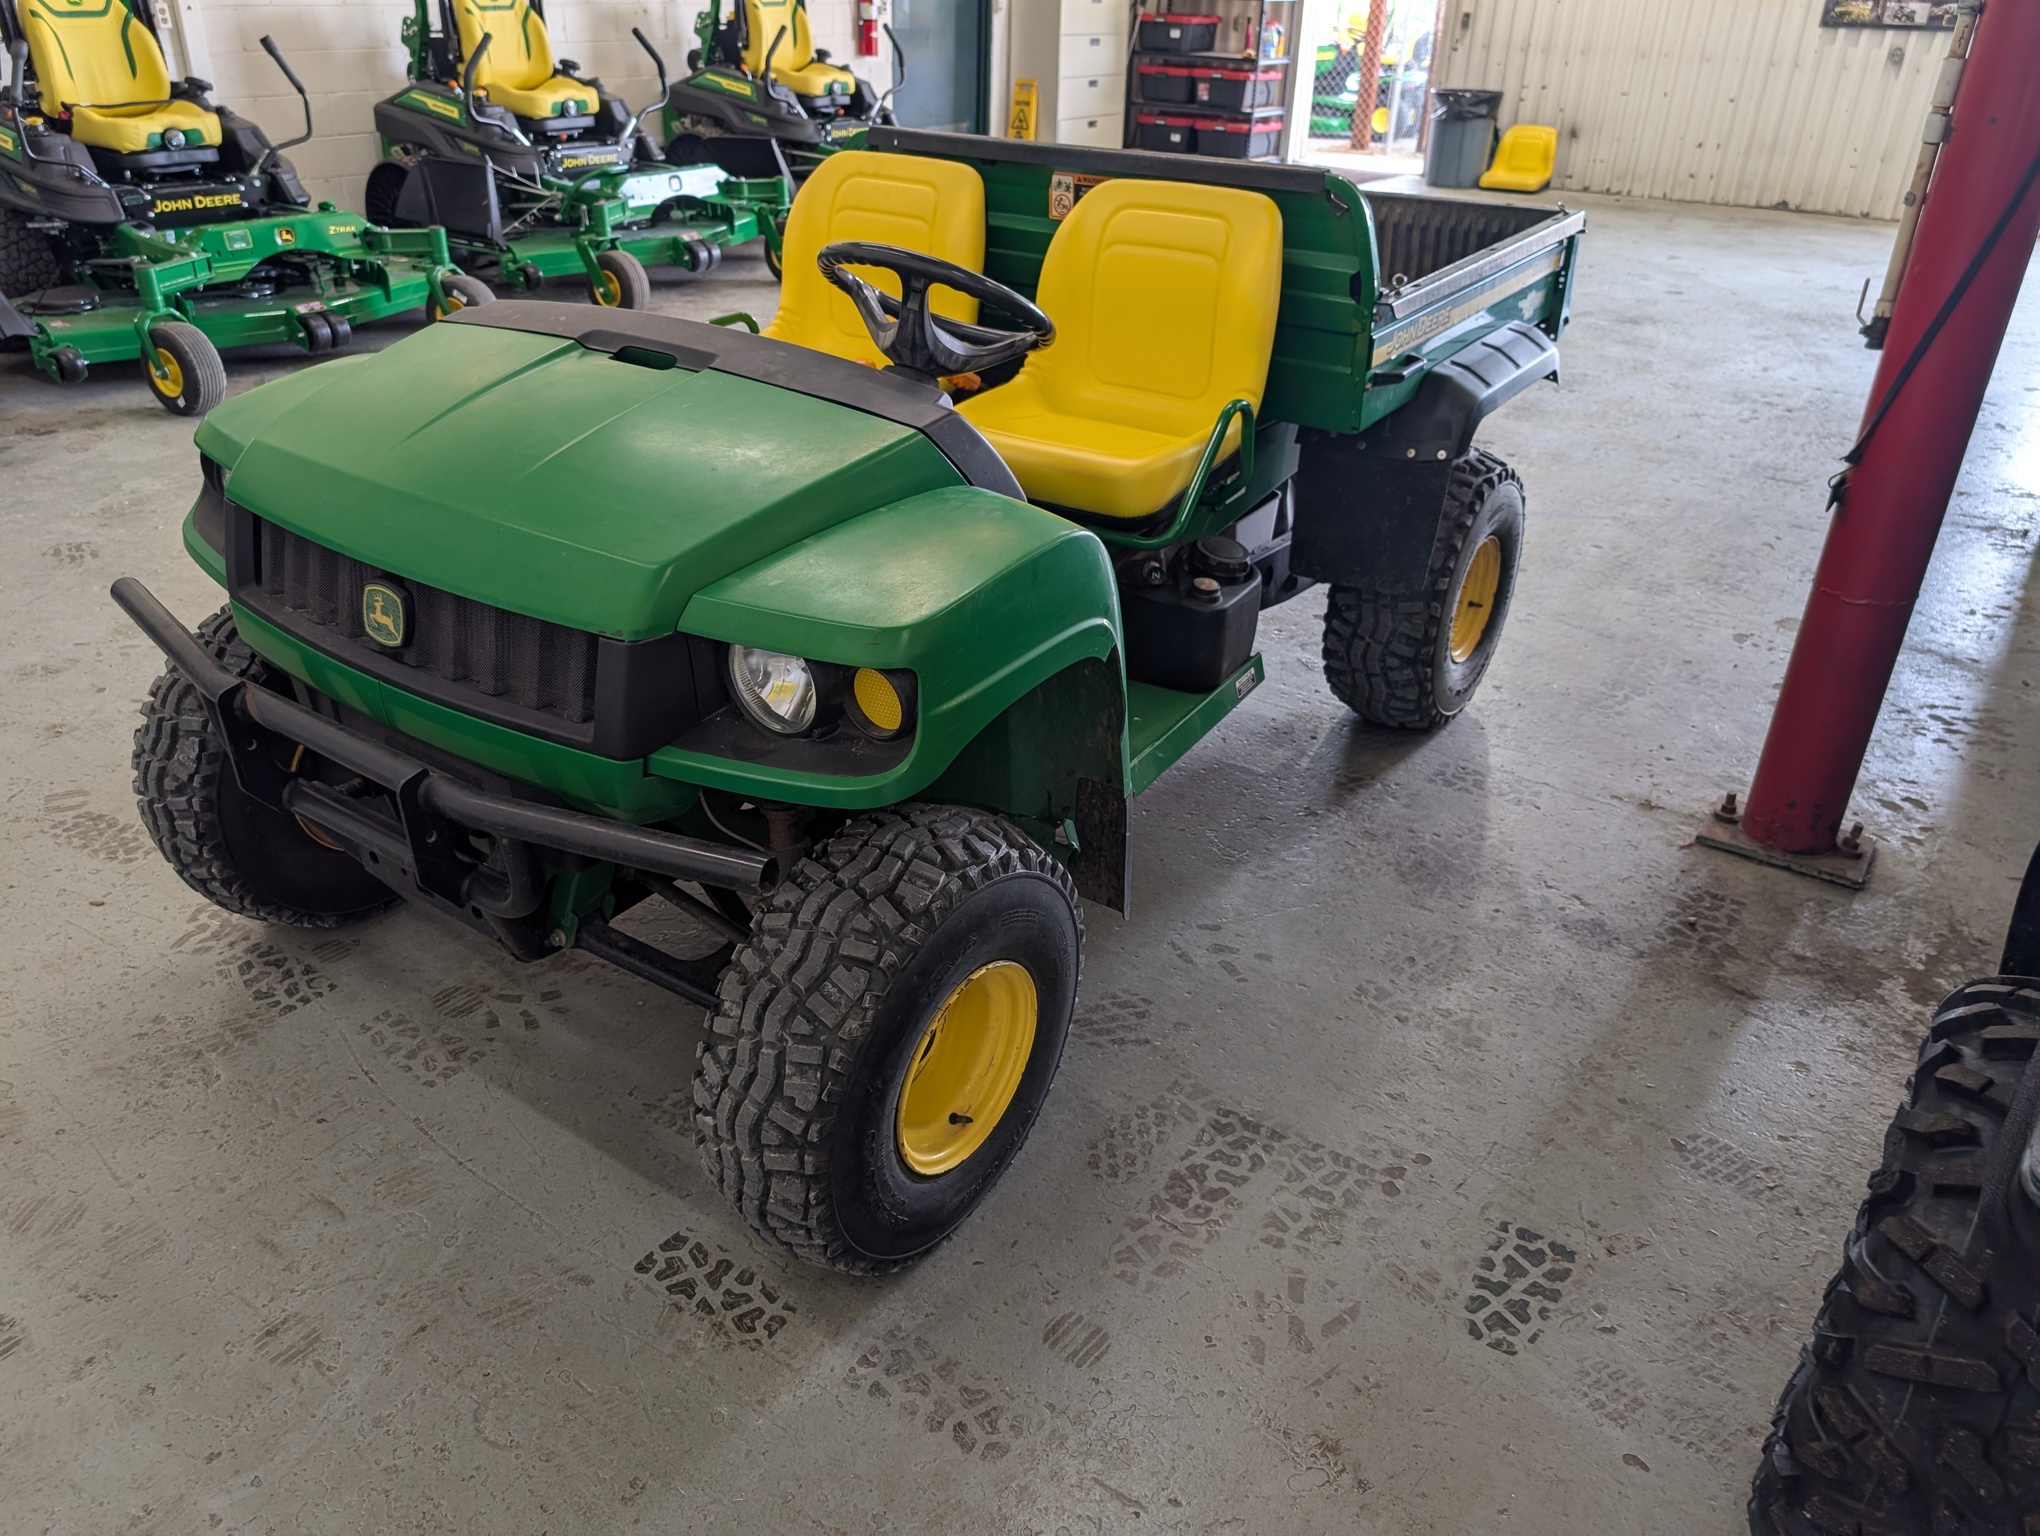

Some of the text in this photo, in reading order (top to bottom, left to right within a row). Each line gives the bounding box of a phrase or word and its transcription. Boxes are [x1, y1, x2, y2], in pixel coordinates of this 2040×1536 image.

[562, 154, 618, 168] JOHN DEERE
[154, 193, 242, 213] JOHN DEERE
[329, 224, 356, 235] ZTRAK
[1386, 307, 1451, 355] JOHN DEERE
